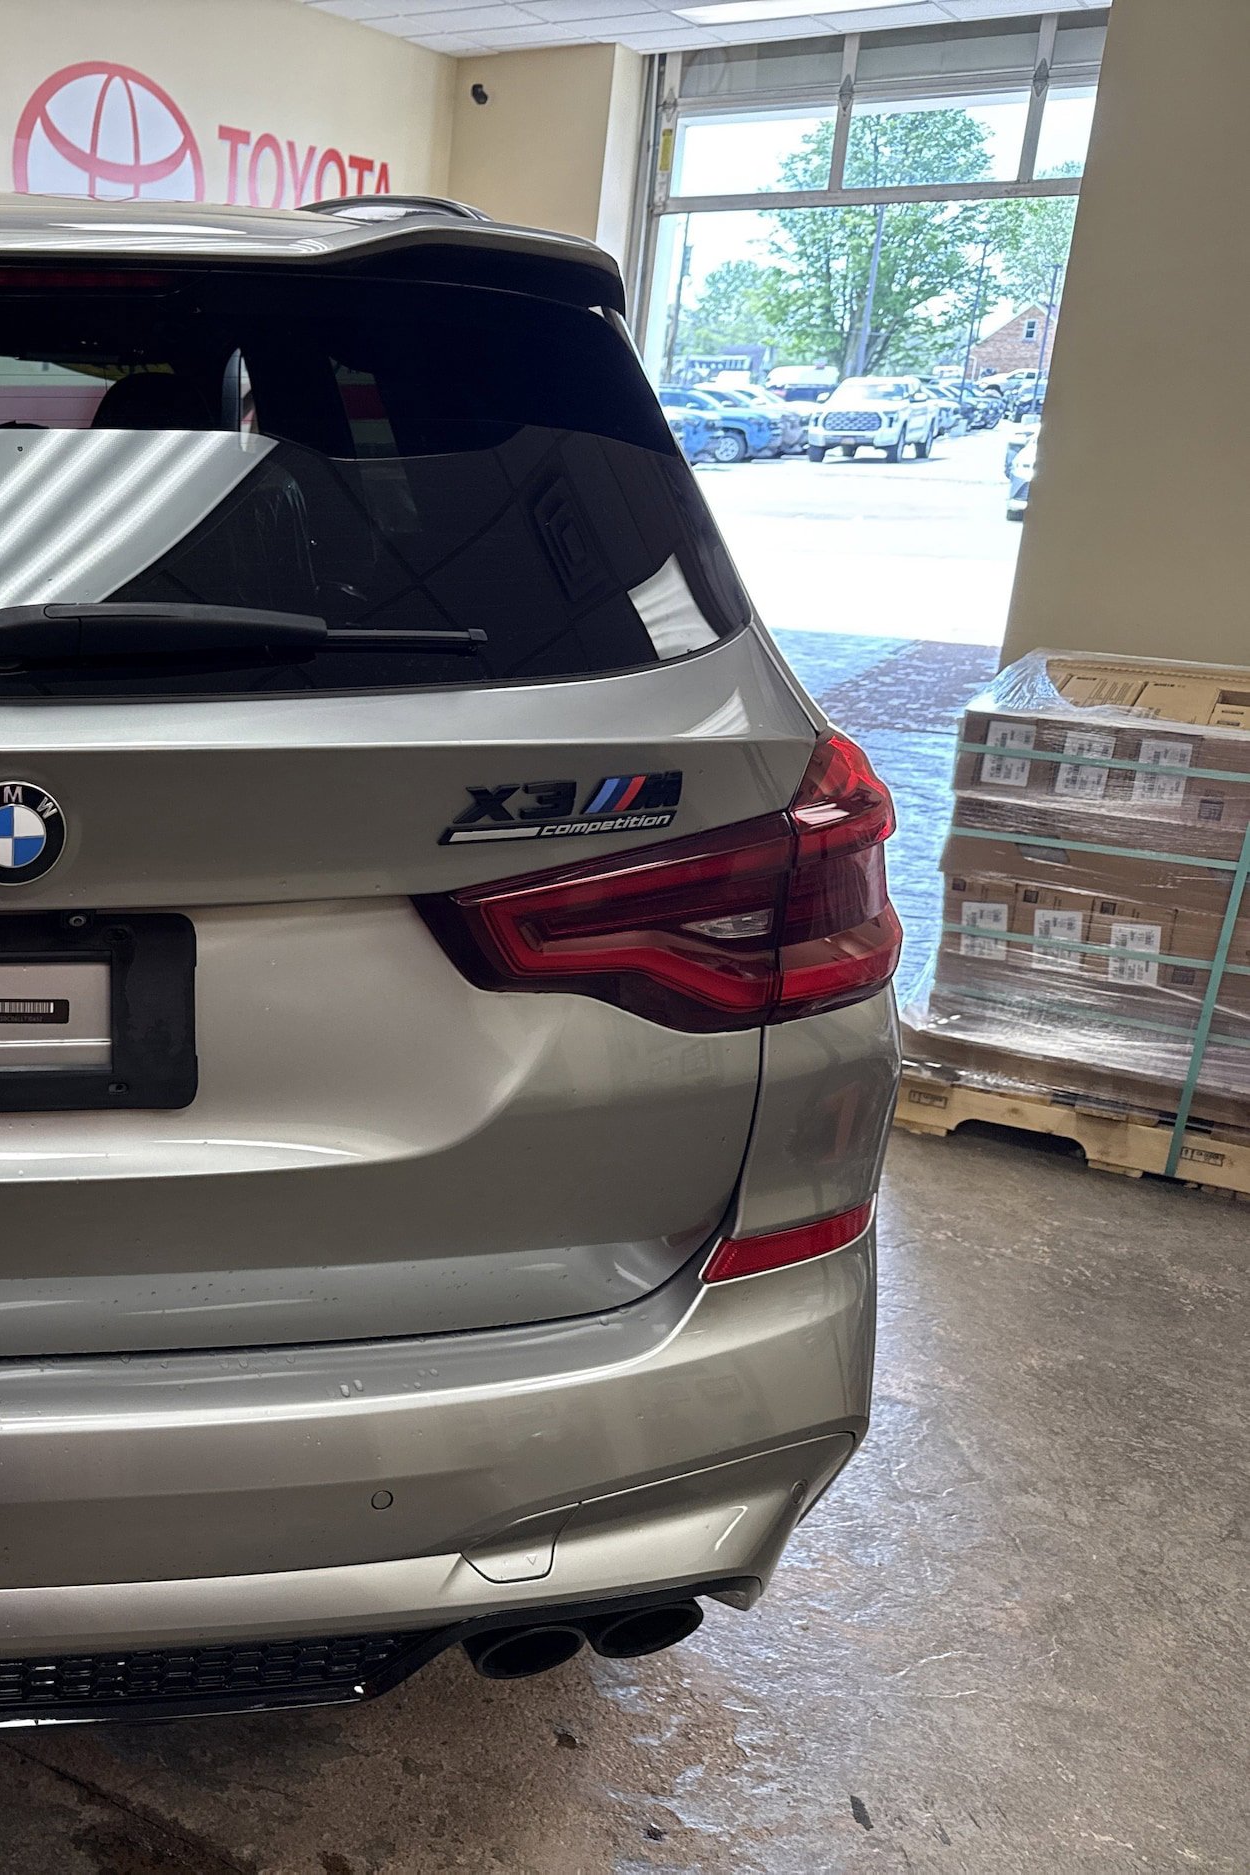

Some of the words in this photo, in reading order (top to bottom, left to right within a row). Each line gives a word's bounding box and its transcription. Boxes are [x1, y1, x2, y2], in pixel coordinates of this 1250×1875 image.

[452, 779, 577, 824] X3
[618, 768, 683, 813] M
[540, 814, 672, 838] competition
